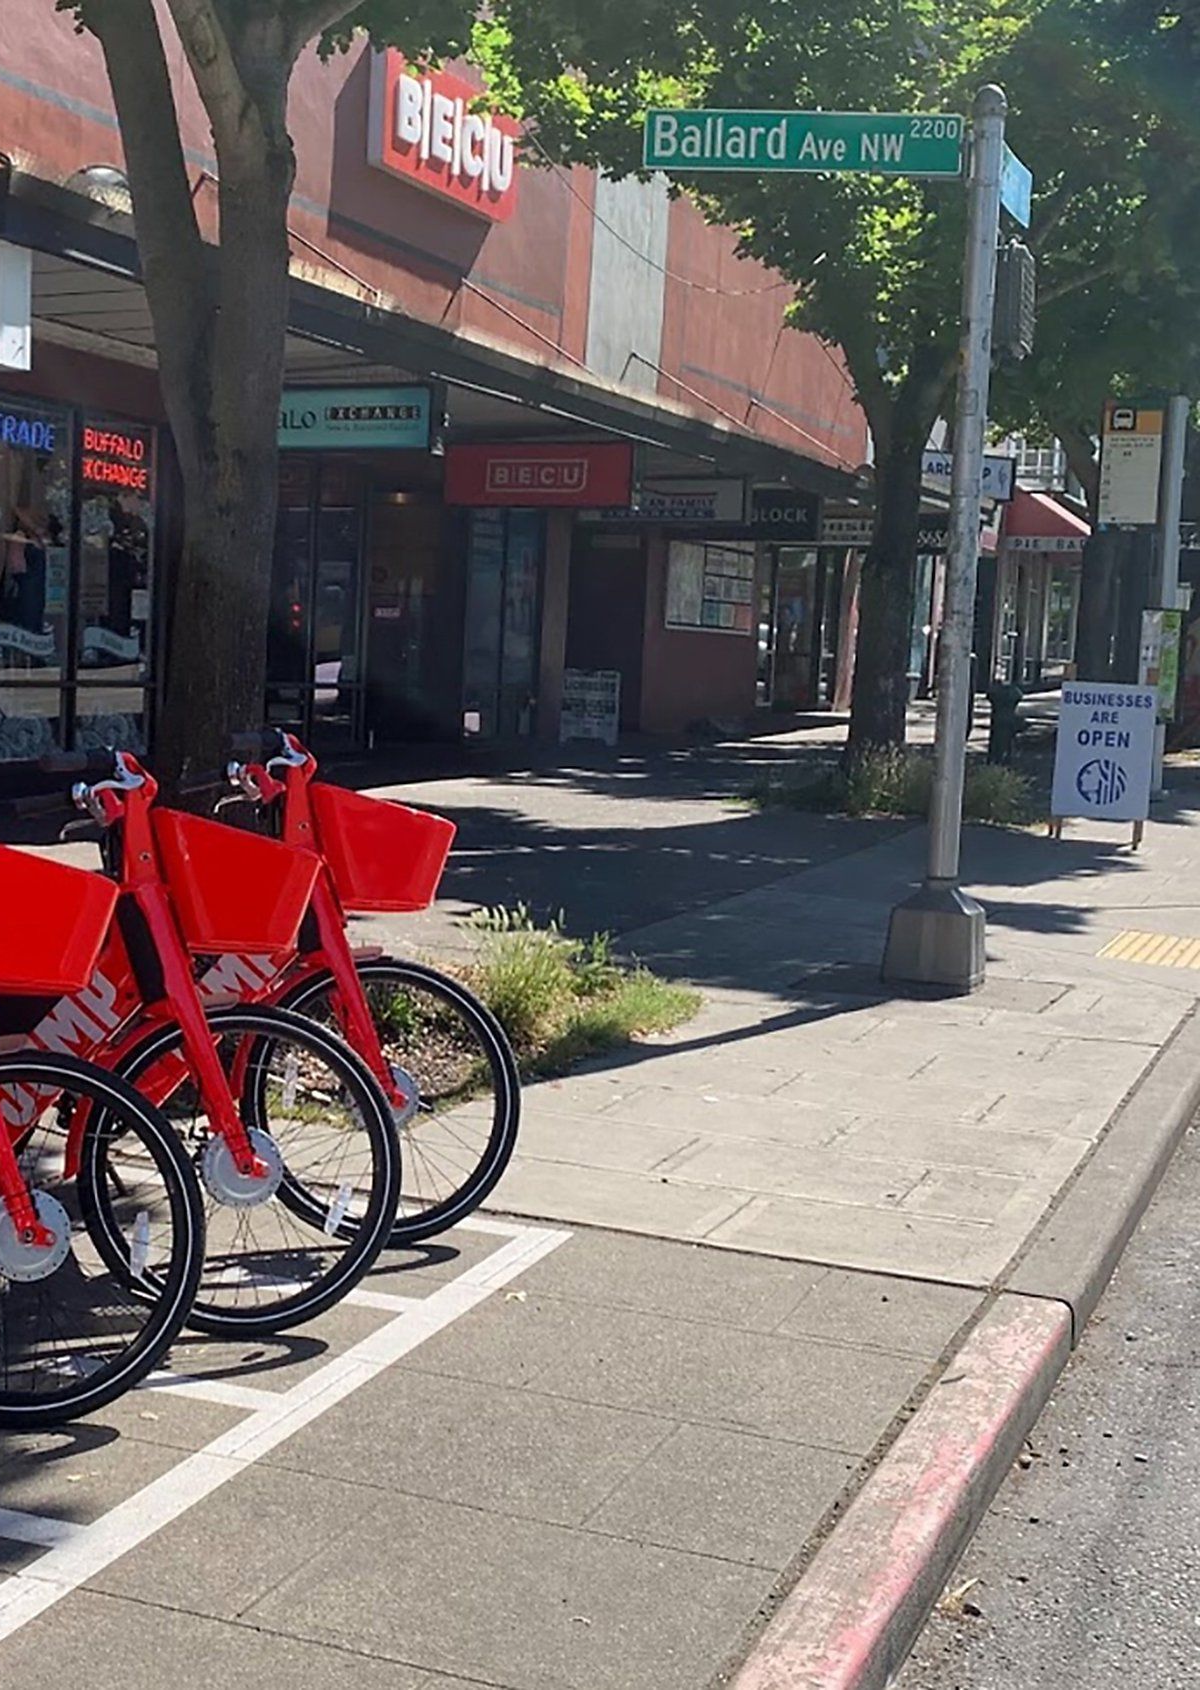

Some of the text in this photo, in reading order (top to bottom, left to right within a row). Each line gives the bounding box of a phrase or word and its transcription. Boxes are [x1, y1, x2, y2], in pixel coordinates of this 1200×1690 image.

[652, 114, 958, 162] Ballard Ave NW 2200
[83, 428, 144, 460] BUFFALO
[1063, 690, 1154, 710] BUSINESSES
[1090, 711, 1120, 725] ARE
[1077, 729, 1131, 749] OPEN
